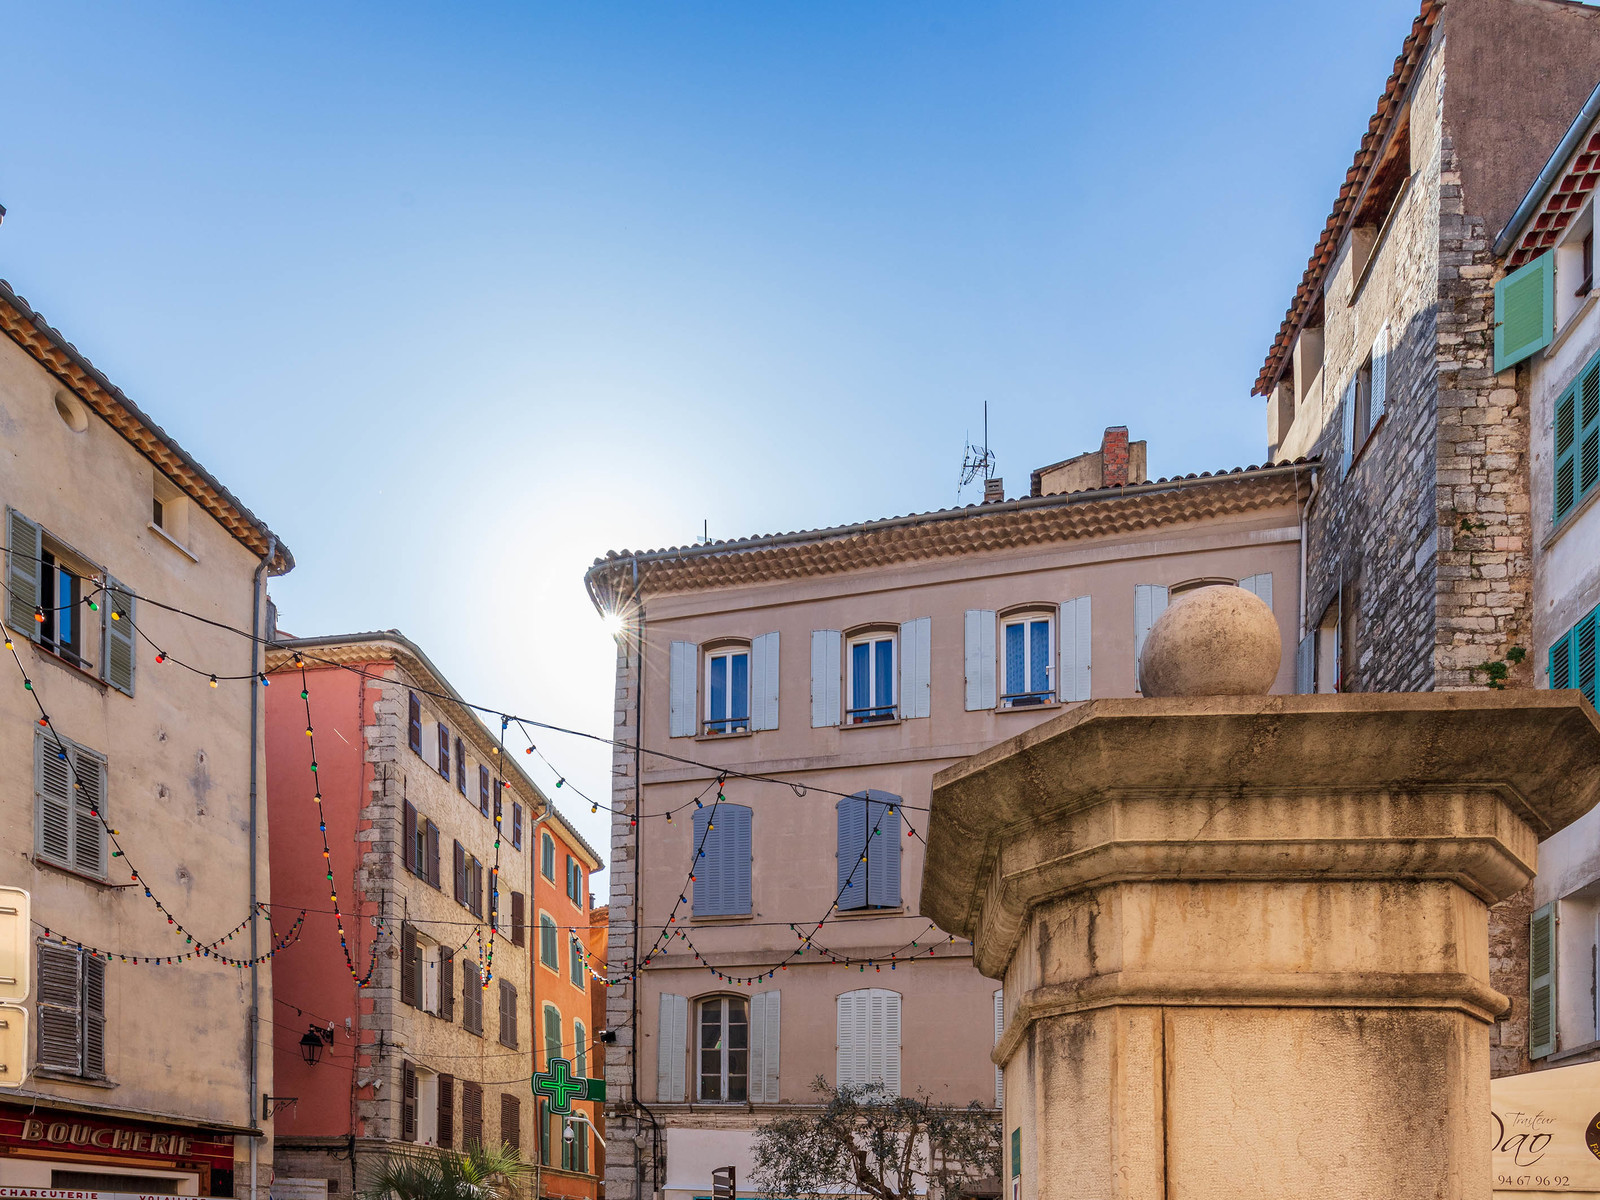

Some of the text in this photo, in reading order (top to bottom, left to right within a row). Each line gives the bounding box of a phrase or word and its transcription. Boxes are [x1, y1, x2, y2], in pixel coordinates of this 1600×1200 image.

[1505, 1110, 1557, 1131] Traiteur
[21, 1118, 194, 1157] BOUCHERIE
[1498, 1174, 1570, 1187] 94 67 96 92
[0, 1188, 98, 1200] CHARCUTERIE
